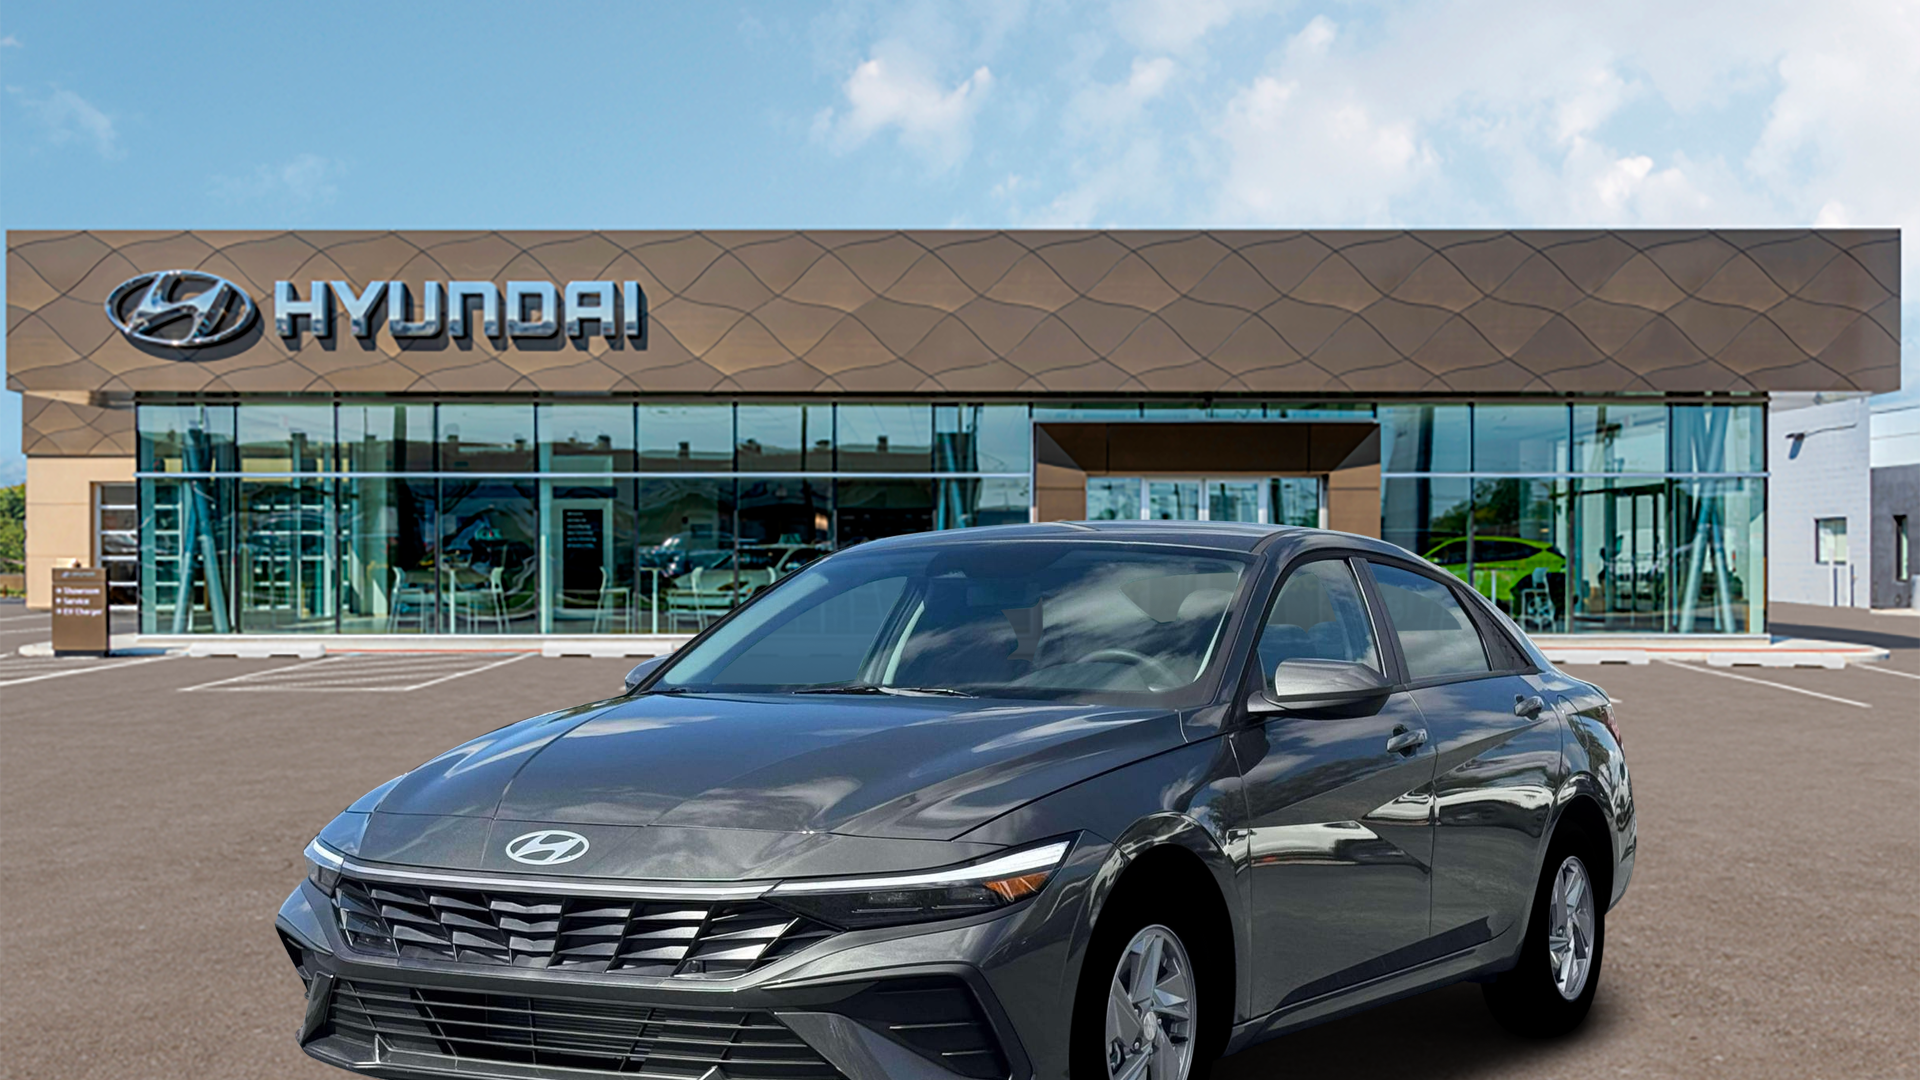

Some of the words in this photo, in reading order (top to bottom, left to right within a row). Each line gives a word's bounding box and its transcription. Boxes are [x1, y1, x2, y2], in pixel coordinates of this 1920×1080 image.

[274, 280, 645, 347] HYUNDAI
[63, 597, 90, 605] Service
[75, 607, 102, 617] Charger
